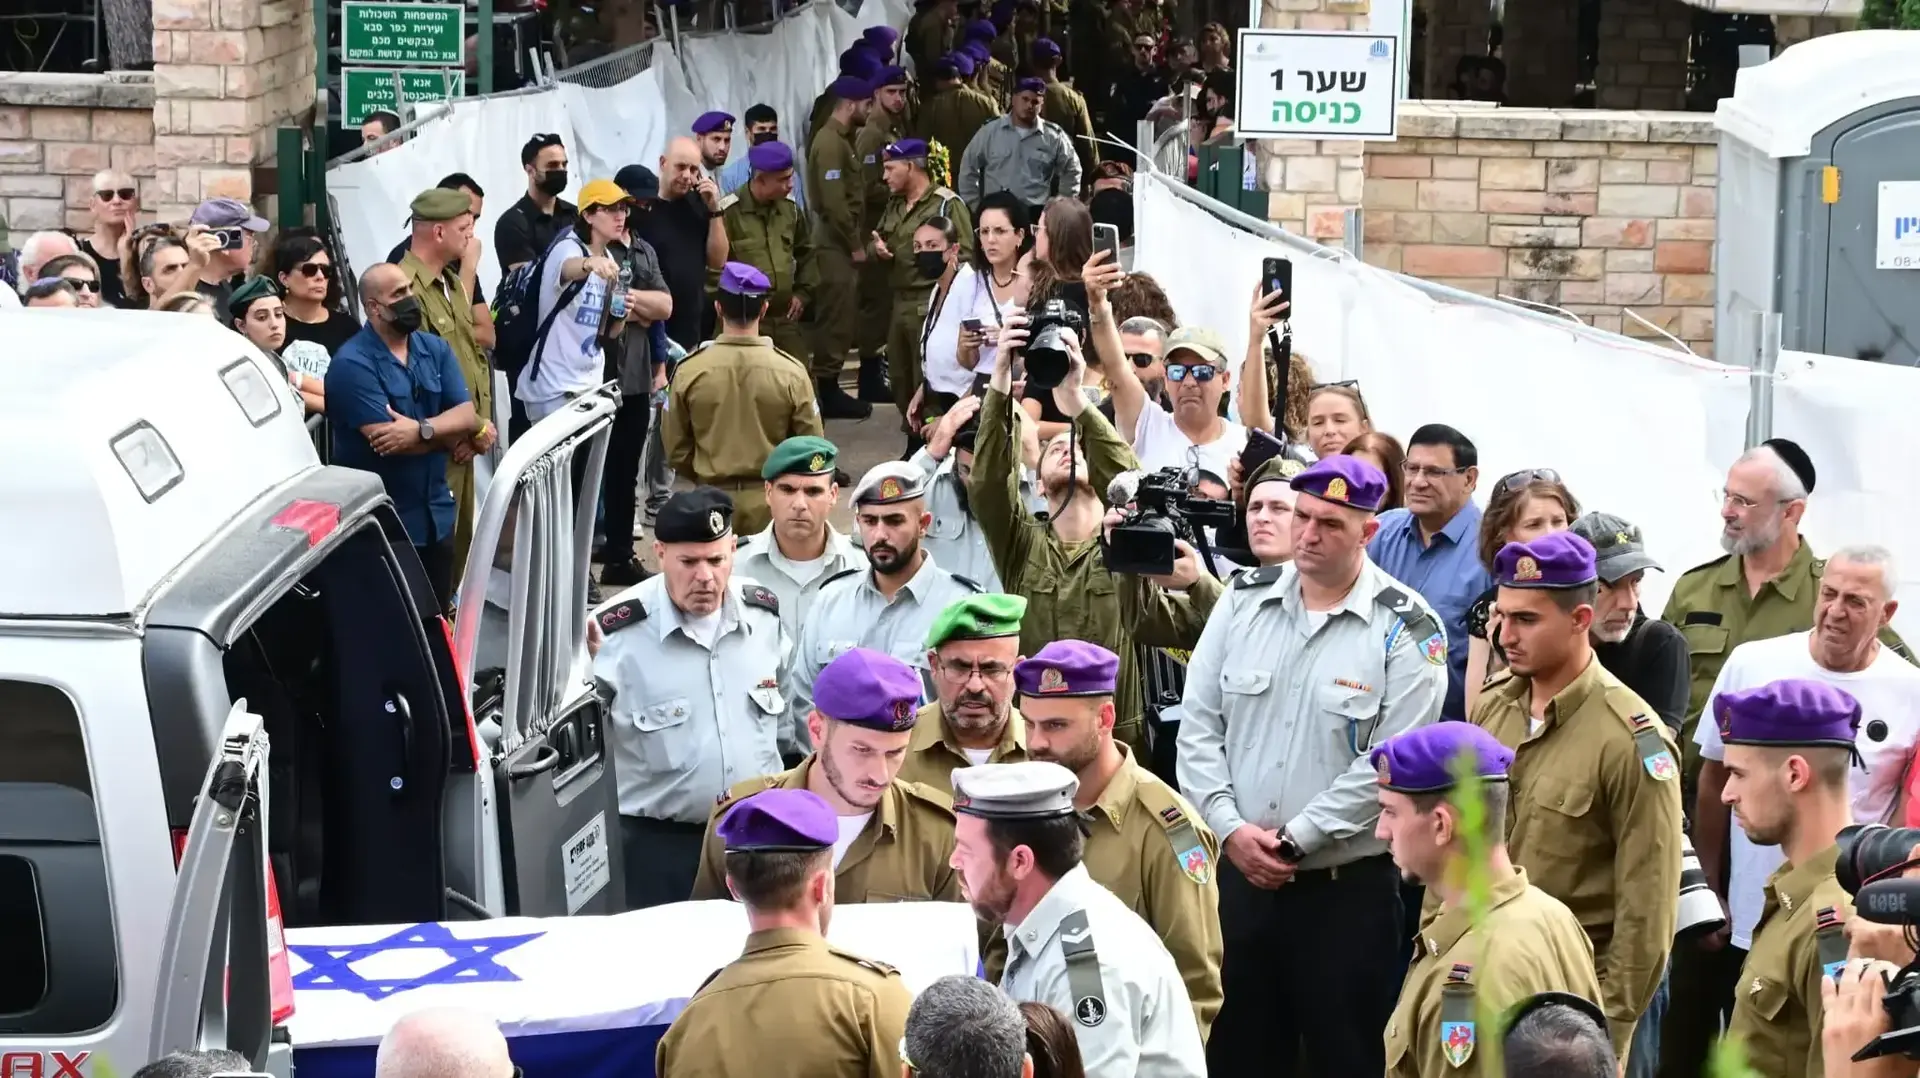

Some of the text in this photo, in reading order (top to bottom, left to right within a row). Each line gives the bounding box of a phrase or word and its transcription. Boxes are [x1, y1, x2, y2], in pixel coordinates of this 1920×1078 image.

[359, 8, 448, 20] המשפחות השכולות
[364, 23, 444, 34] ועיריית כפר סבא
[372, 36, 435, 48] מבקשים מכם
[349, 48, 457, 60] אנא כבדו את קדושת המקום
[413, 78, 432, 88] אנא
[1270, 69, 1367, 93] שער 1
[367, 89, 394, 99] כלבים
[1272, 101, 1361, 124] כניסה
[1894, 256, 1920, 267] 08-
